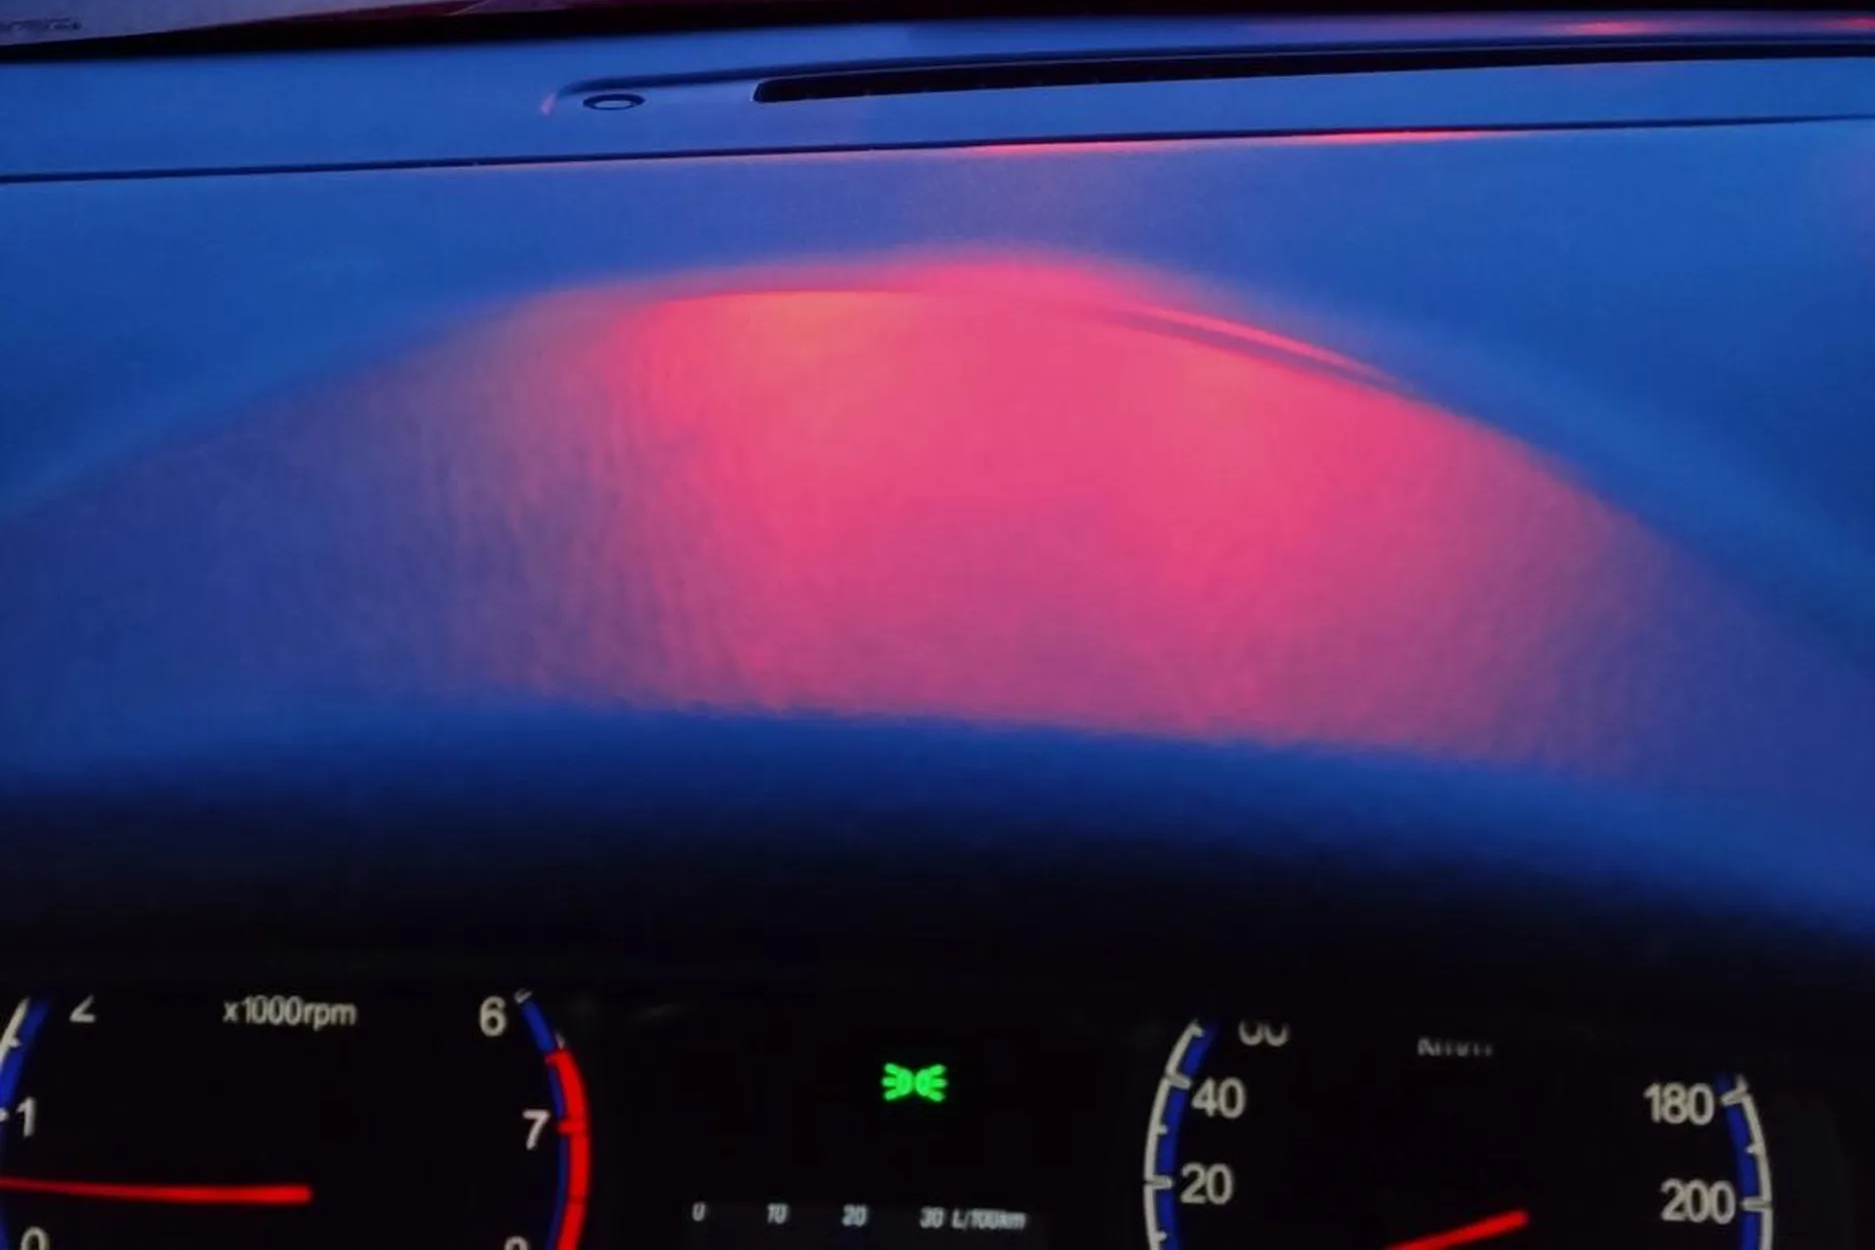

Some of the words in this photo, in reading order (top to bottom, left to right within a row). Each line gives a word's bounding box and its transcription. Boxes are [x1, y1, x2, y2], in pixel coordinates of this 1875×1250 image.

[222, 995, 358, 1031] x1000rpm
[479, 996, 507, 1037] 6
[16, 1096, 37, 1137] 1
[1192, 1077, 1246, 1119] 40
[1644, 1083, 1716, 1126] 180
[522, 1109, 550, 1150] 7
[1180, 1162, 1234, 1205] 20
[1661, 1180, 1737, 1225] 200
[767, 1203, 789, 1225] 10
[842, 1204, 868, 1227] 20
[920, 1206, 945, 1229] 30
